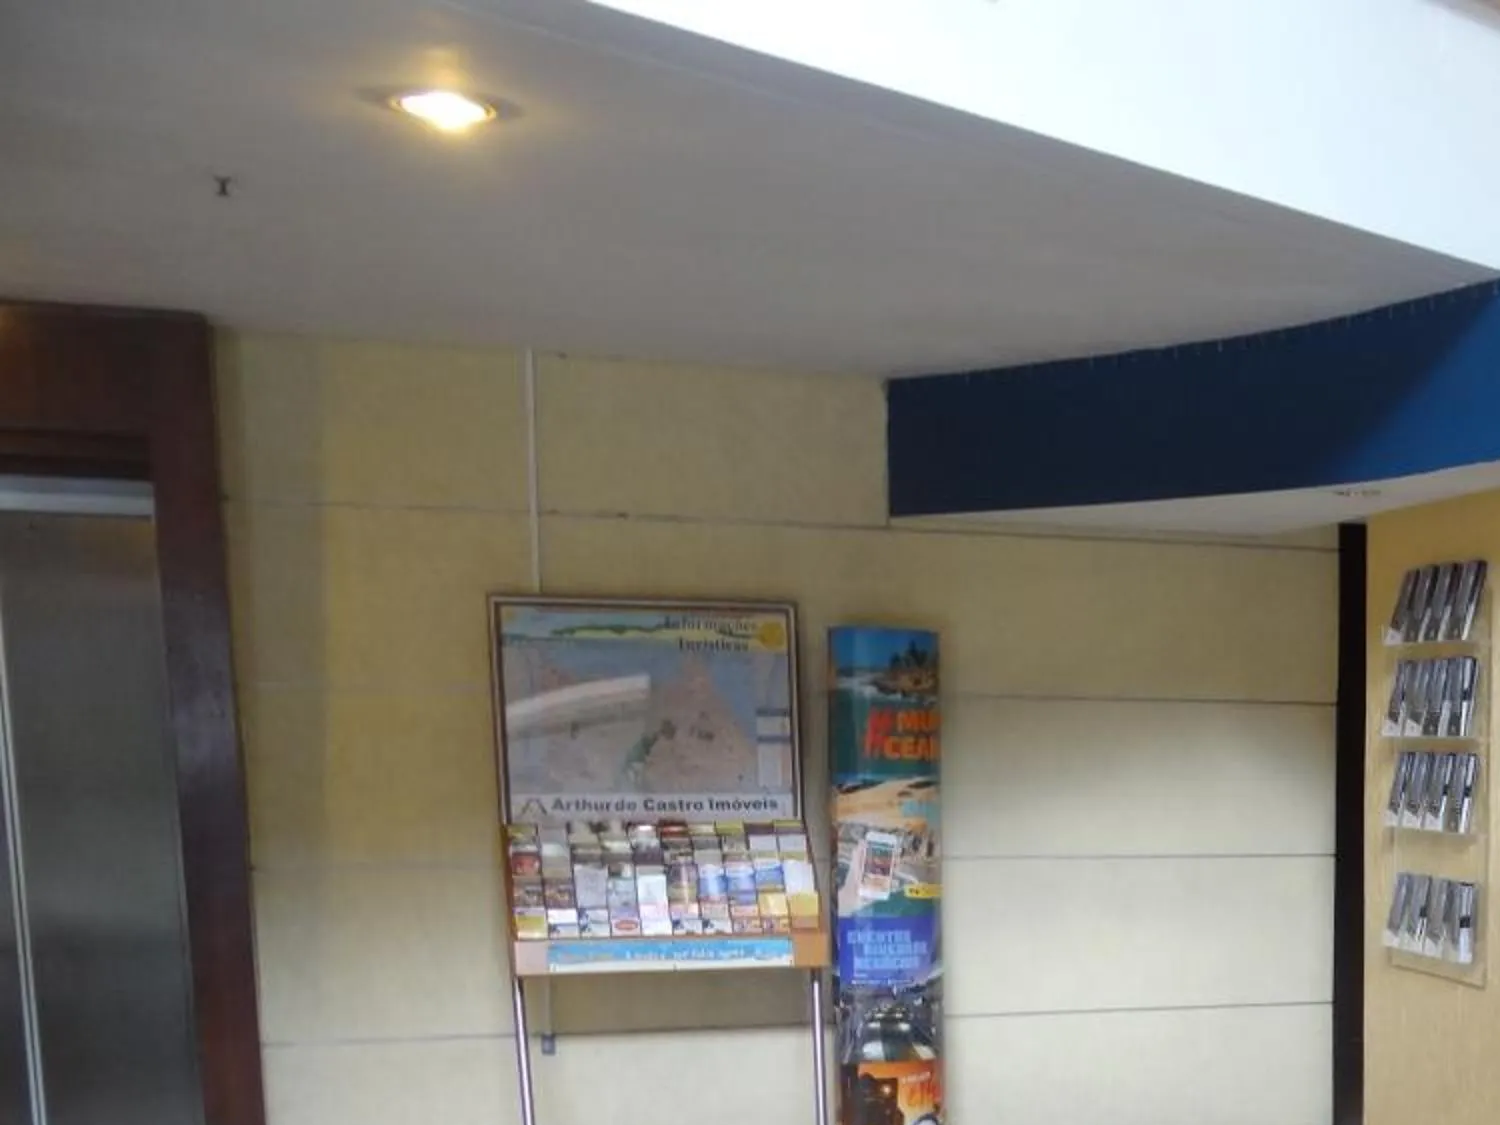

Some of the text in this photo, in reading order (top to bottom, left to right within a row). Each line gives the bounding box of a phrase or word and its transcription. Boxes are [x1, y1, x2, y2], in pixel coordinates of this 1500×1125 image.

[551, 797, 610, 811] Arthur
[643, 797, 704, 811] Castro
[708, 796, 779, 811] Imóveis
